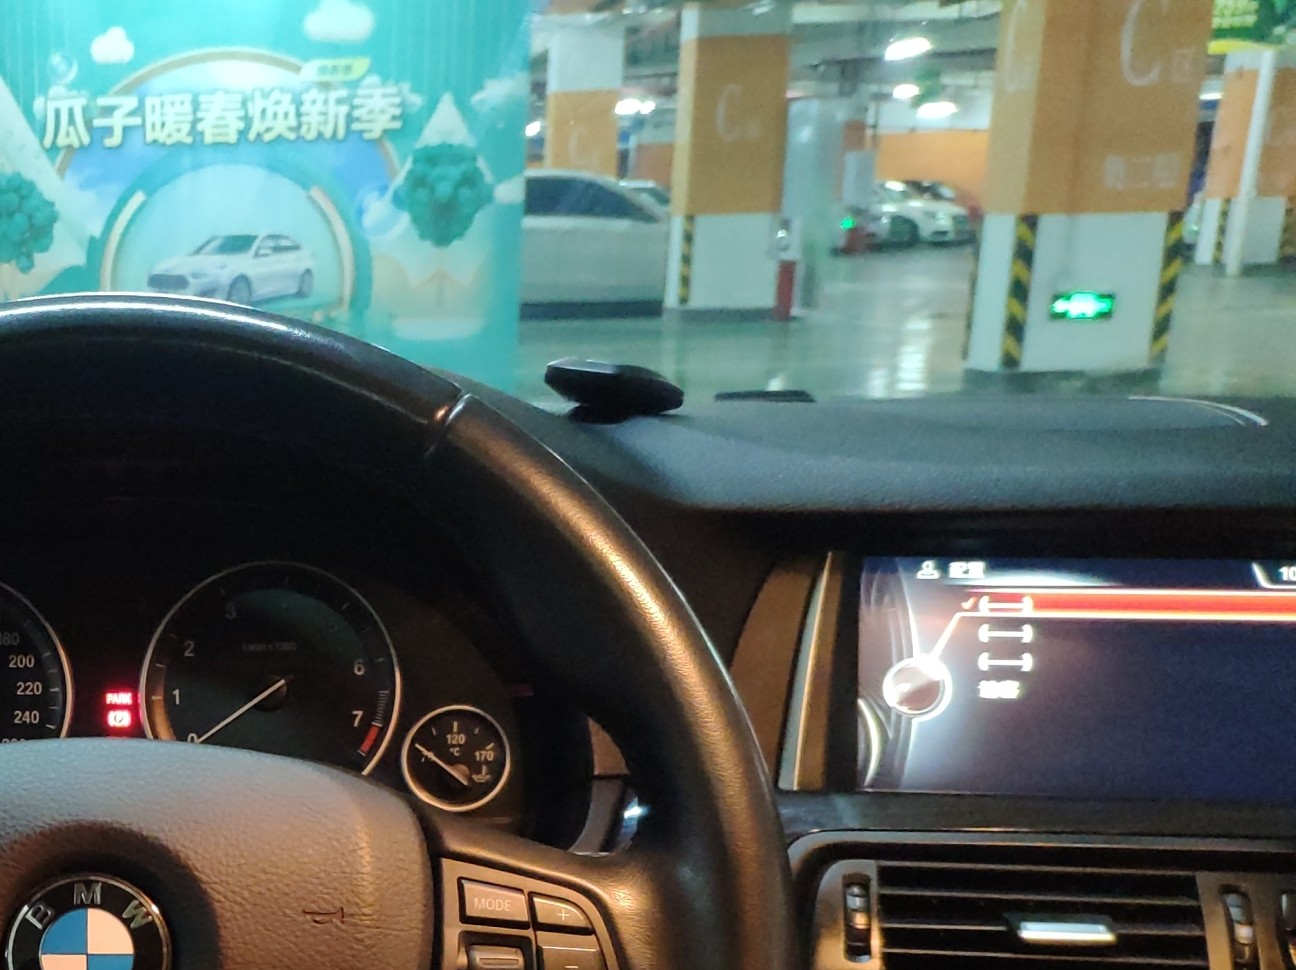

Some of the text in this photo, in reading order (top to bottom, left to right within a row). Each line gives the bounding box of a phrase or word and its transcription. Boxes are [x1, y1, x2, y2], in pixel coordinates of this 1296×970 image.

[42, 86, 404, 149] 瓜子暖春焕新季
[184, 641, 195, 657] 2
[8, 654, 35, 668] 200
[353, 659, 365, 675] 6
[16, 681, 43, 695] 220
[106, 692, 133, 705] PARK
[172, 688, 181, 705] 1
[13, 710, 40, 724] 240
[353, 711, 364, 728] 7
[446, 734, 466, 745] 120
[475, 751, 494, 762] 170
[25, 881, 154, 930] BMW
[473, 897, 512, 912] MODE
